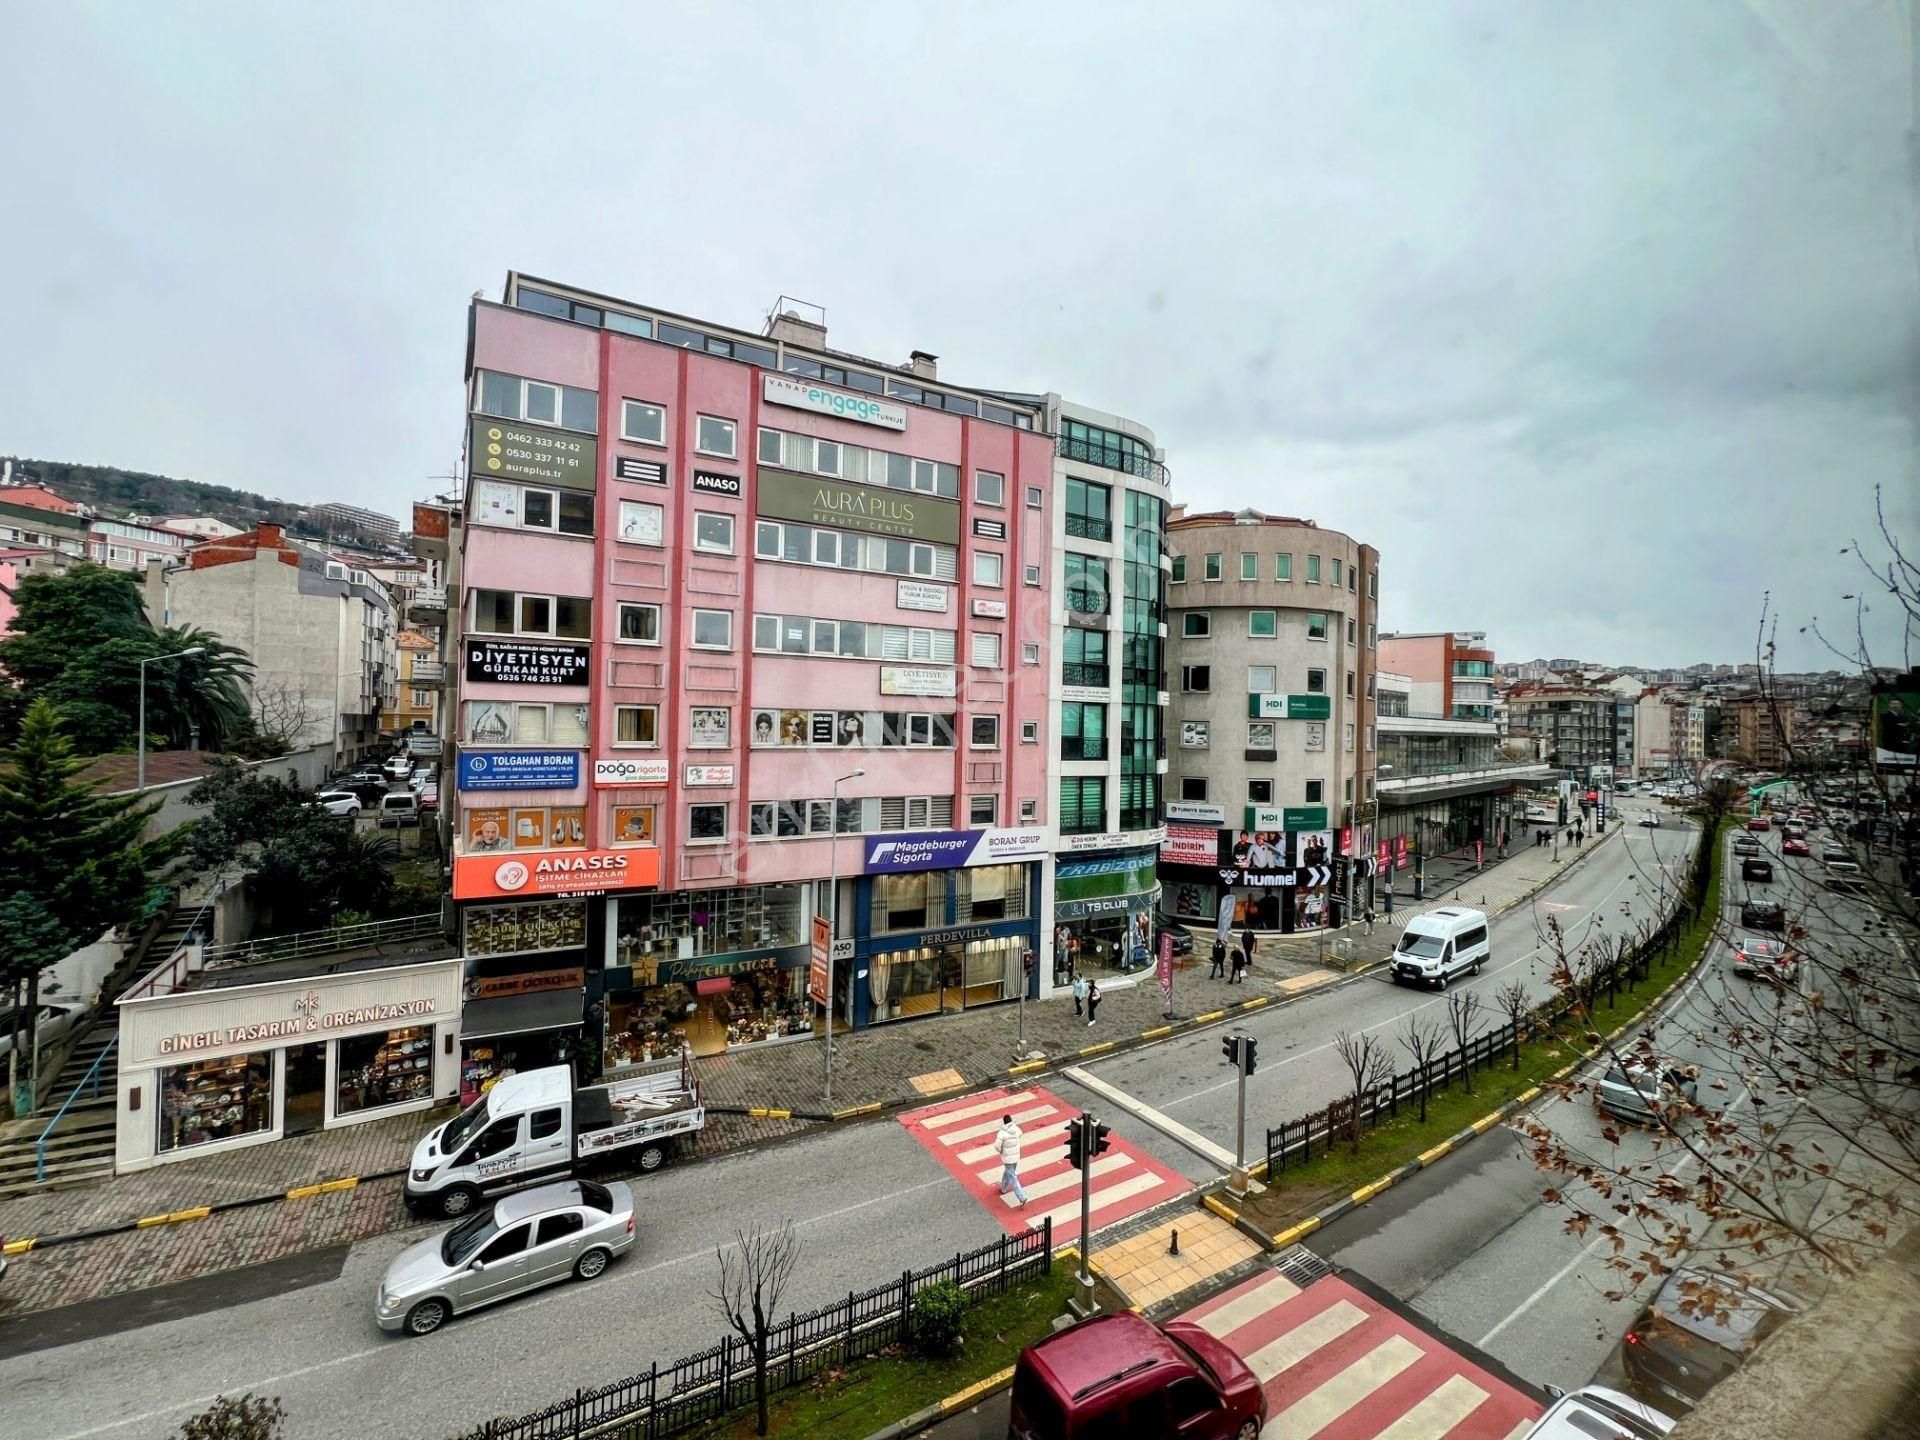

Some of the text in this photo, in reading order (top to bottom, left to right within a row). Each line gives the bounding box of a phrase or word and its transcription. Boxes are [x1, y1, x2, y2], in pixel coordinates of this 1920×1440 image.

[769, 380, 807, 393] VANAD
[808, 389, 880, 419] engage
[507, 432, 580, 453] 0462 333 42 42
[506, 448, 579, 467] 0530 337 11 61
[506, 463, 562, 478] auraplus.tr
[696, 475, 738, 491] ANASO
[813, 489, 914, 521] AURA PLUS
[813, 513, 914, 534] BEAUTY CENTER
[472, 650, 586, 667] DİYETİSYEN
[483, 664, 575, 676] GÜRKAN KURT
[1266, 700, 1282, 708] HDI
[492, 756, 574, 765] TOLGAHAN BORAN
[636, 766, 667, 775] sigorta
[1262, 814, 1278, 822] HDI
[895, 838, 967, 852] Magdeburger
[989, 835, 1041, 846] BORAN GRUP
[1172, 841, 1205, 851] İNDİRİM
[535, 855, 628, 873] ANASES
[893, 852, 932, 864] Sigorta
[574, 870, 627, 880] CİHAZLARI
[1244, 870, 1296, 886] hummel
[1103, 900, 1128, 910] CLUB
[920, 928, 992, 945] PERDEVILLA
[834, 942, 852, 951] ASO
[738, 957, 777, 972] STORE
[160, 999, 436, 1054] CİNGIL TASARIM & ORGANİZASYON
